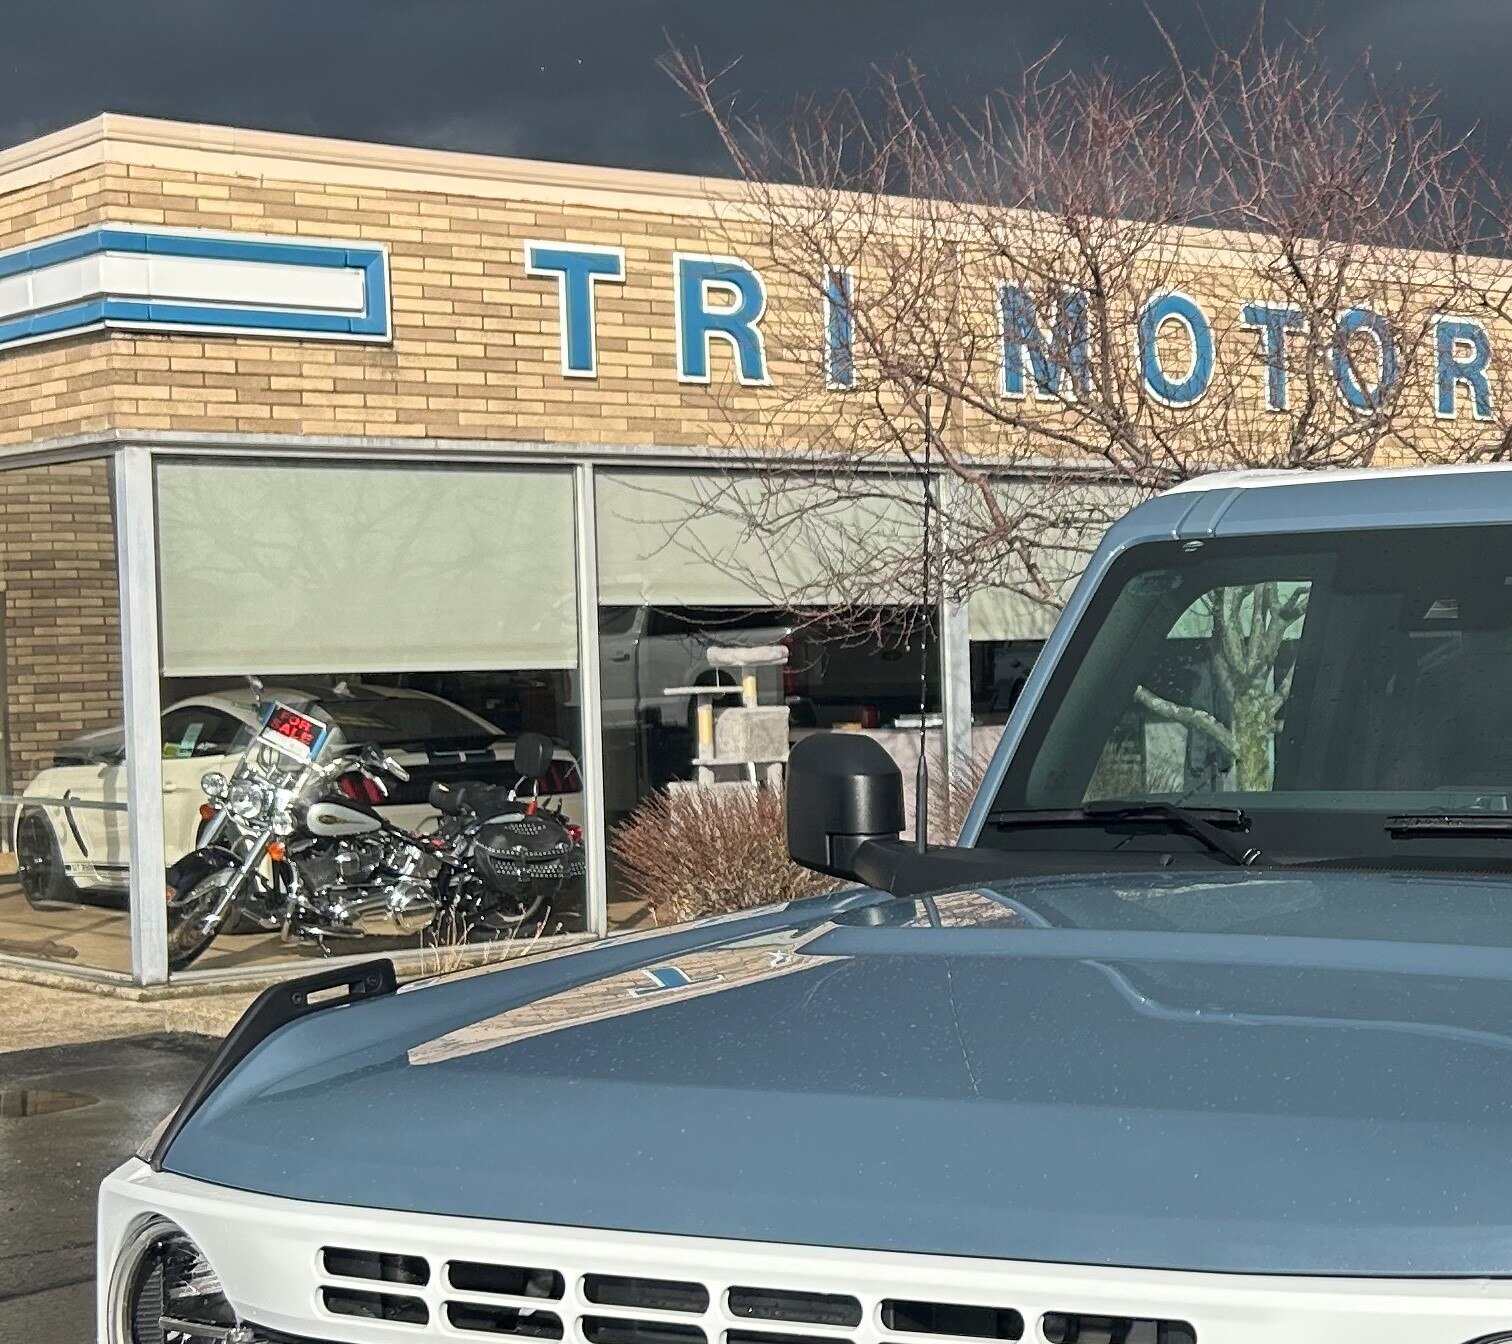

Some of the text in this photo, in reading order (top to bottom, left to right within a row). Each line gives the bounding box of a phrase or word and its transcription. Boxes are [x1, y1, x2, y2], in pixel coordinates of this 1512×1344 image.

[522, 239, 858, 390] TRI
[1000, 282, 1494, 421] MOTOR
[270, 718, 315, 746] SALE
[280, 711, 313, 732] FOR
